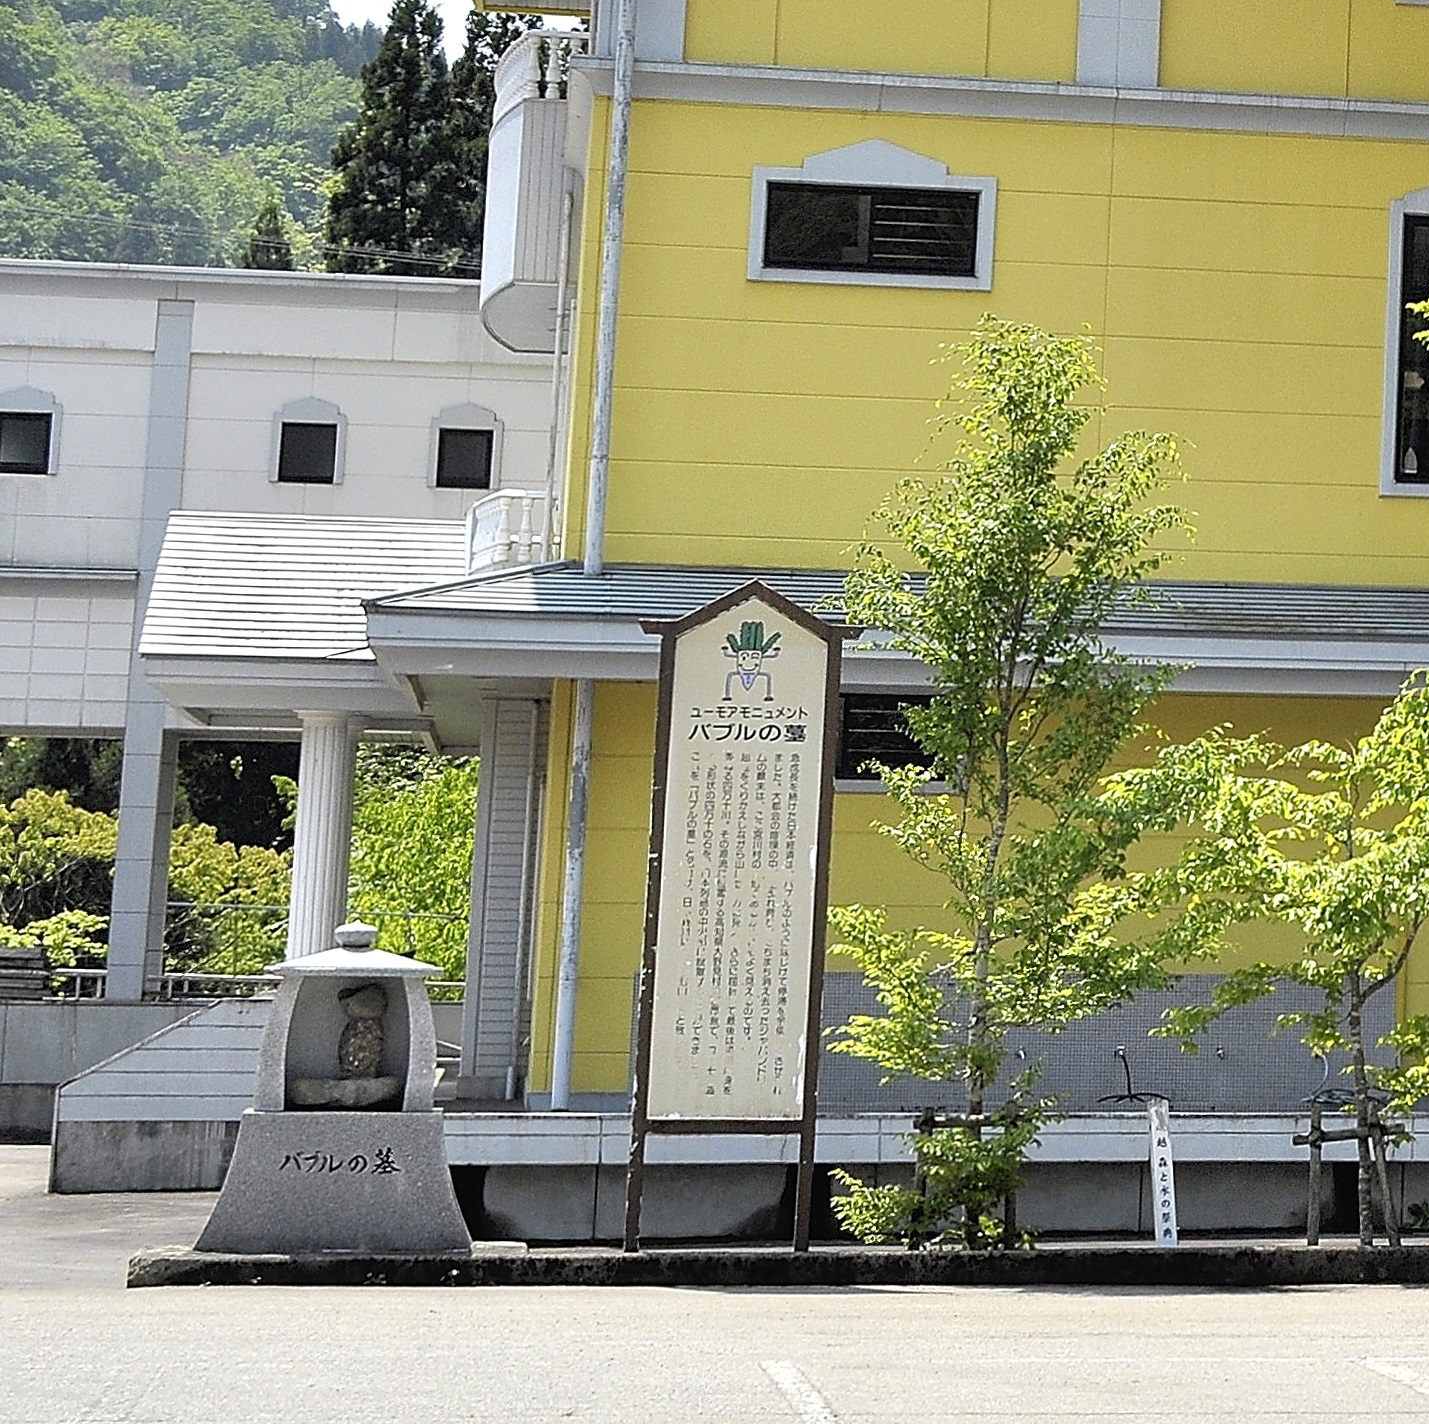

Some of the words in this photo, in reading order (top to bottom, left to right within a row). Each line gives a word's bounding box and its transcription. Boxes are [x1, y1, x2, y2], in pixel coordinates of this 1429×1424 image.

[690, 706, 808, 720] ユーモアモニュメント
[688, 723, 807, 742] バブルの墓
[279, 1146, 401, 1175] バブルの墓
